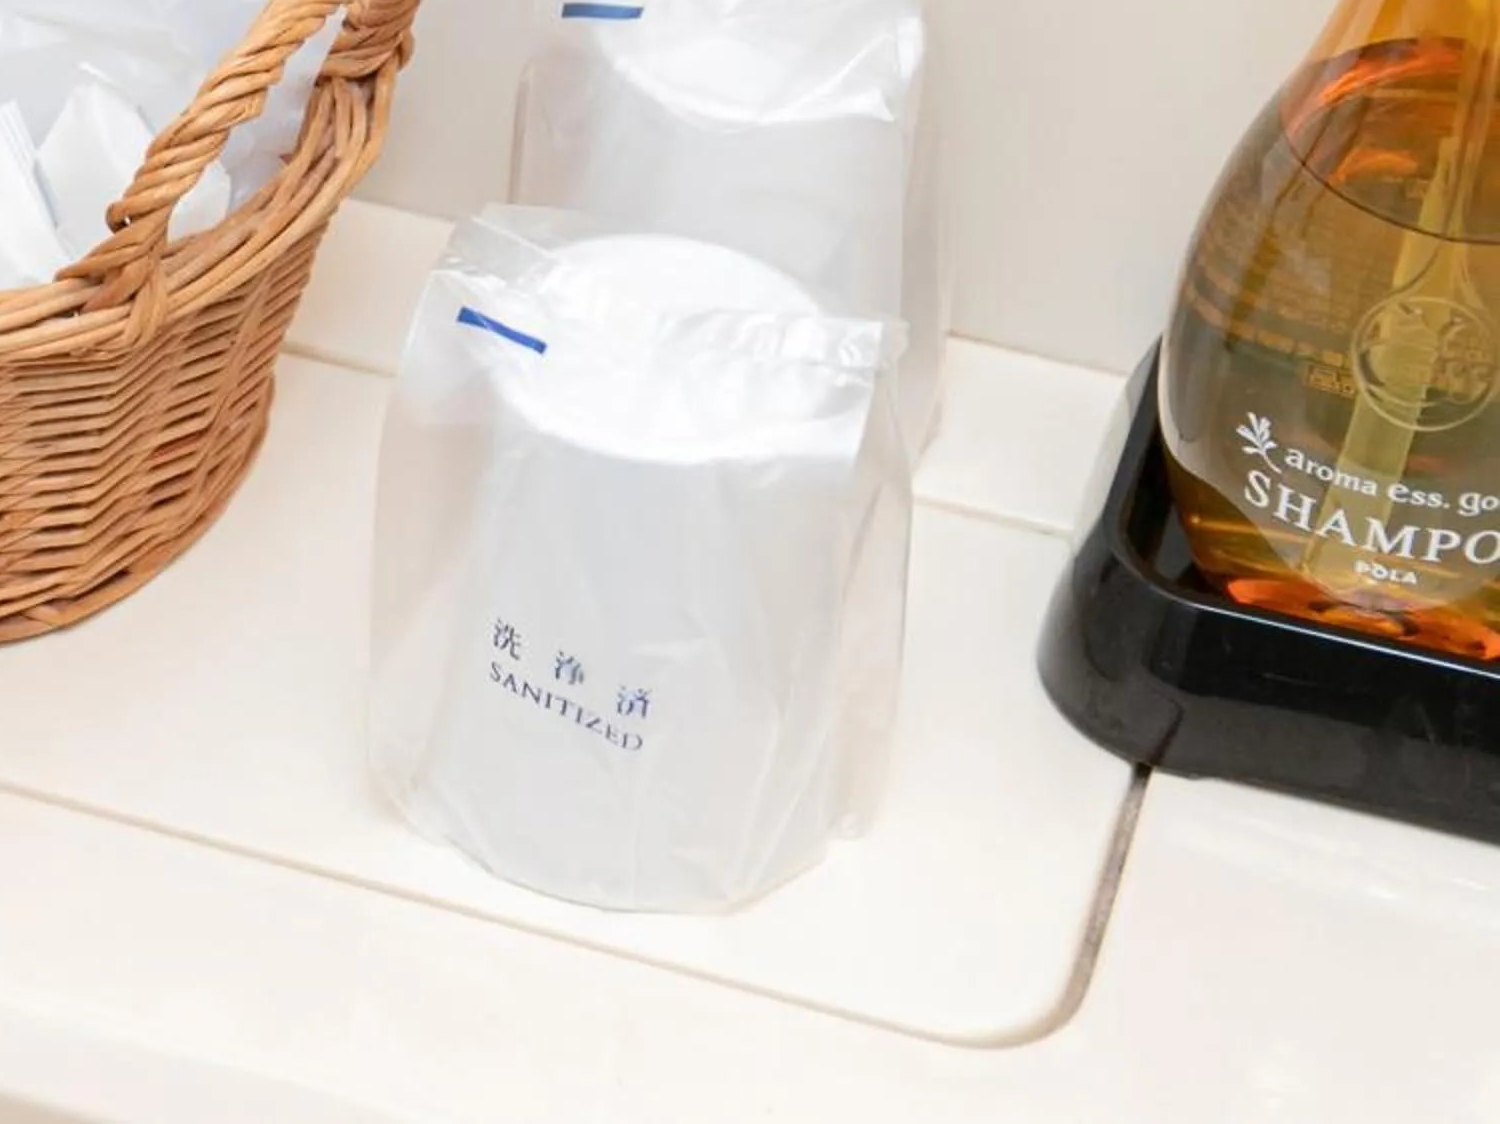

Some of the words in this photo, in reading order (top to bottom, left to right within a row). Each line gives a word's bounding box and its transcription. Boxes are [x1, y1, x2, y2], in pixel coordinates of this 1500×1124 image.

[1284, 447, 1378, 496] aroma
[1387, 480, 1451, 510] ess.
[1355, 560, 1417, 584] POLA
[489, 660, 644, 752] SANITIZED
